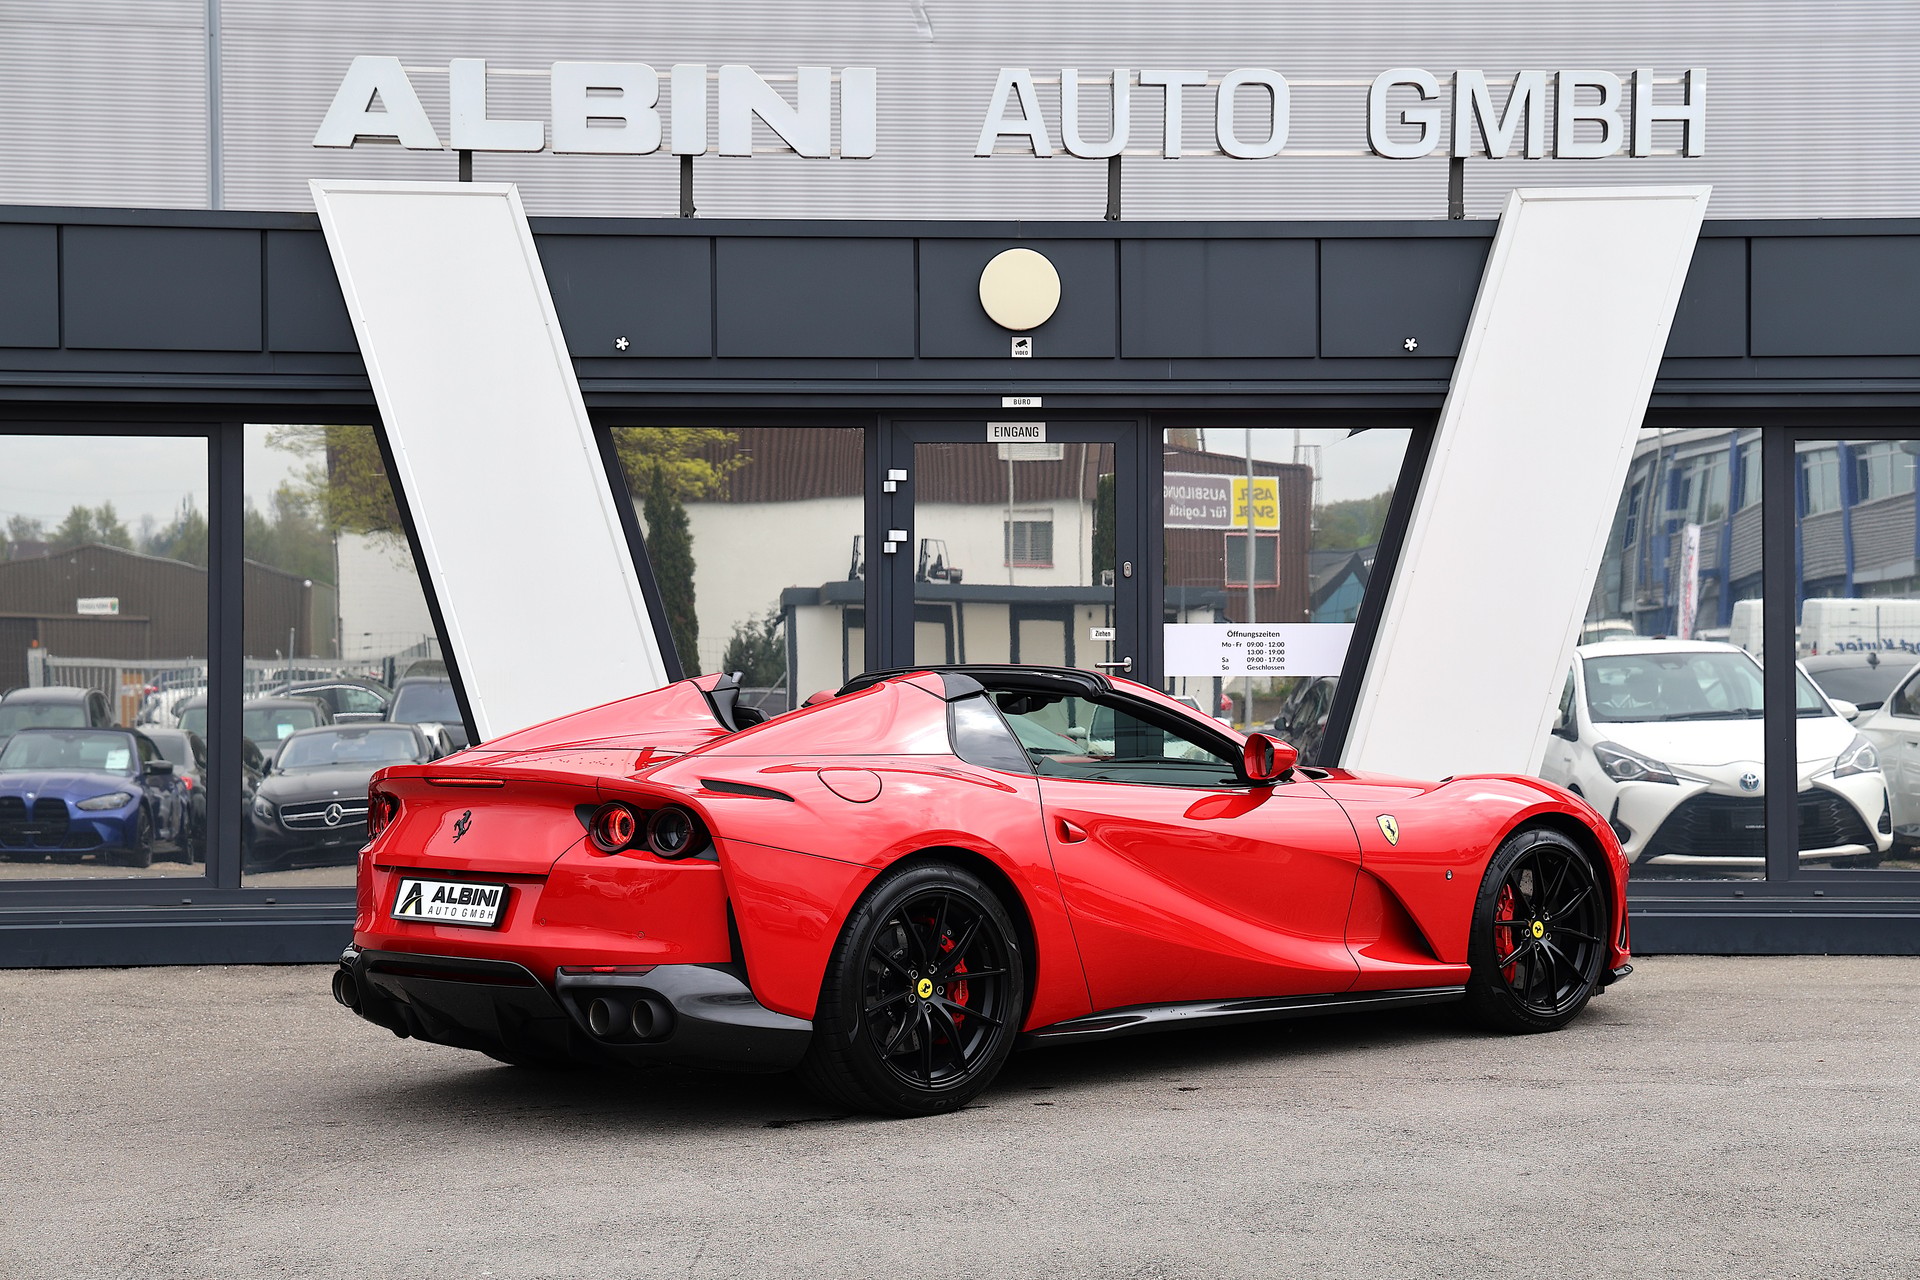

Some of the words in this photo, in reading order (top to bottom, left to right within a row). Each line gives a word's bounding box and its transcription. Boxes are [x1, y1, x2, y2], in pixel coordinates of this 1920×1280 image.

[312, 55, 877, 159] ALBINI
[973, 67, 1291, 160] AUTO
[1367, 67, 1708, 160] GMBH
[1013, 397, 1031, 405] BÜRO
[994, 426, 1039, 438] EINGANG
[1226, 630, 1280, 639] Öffnungszeiten
[431, 886, 500, 908] ALBINI
[427, 906, 457, 917] AUTO
[461, 908, 495, 919] GMBH
